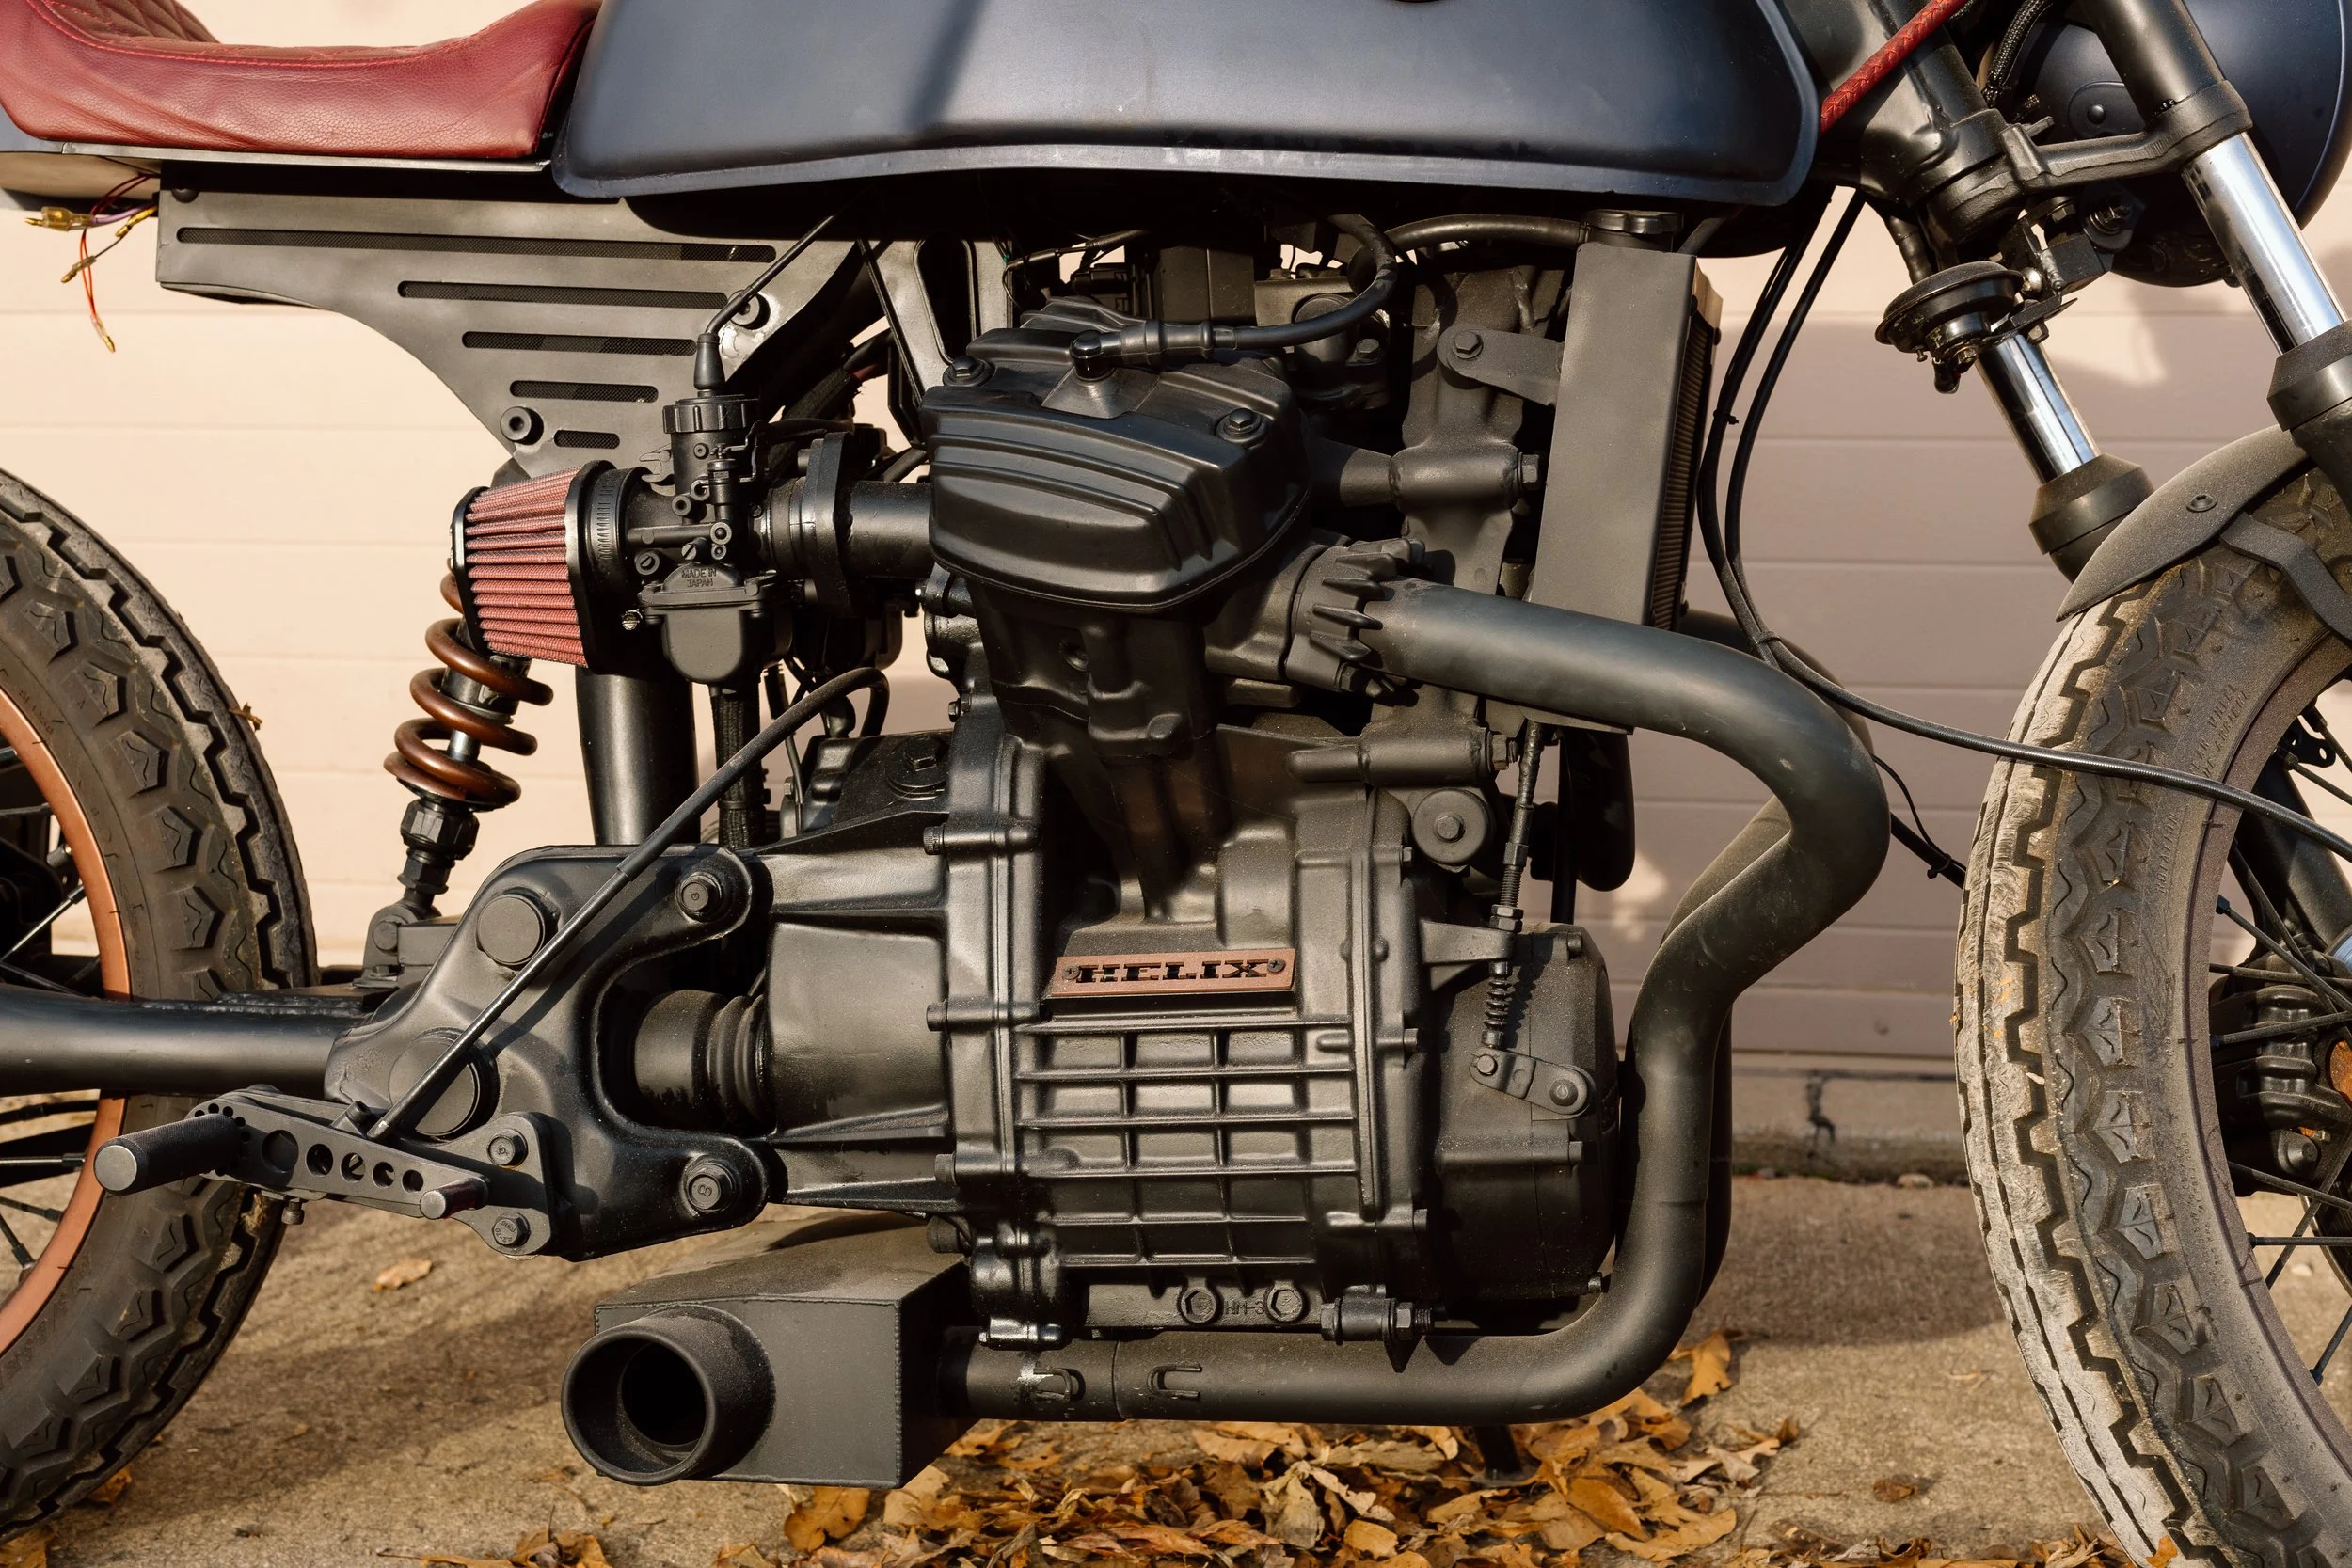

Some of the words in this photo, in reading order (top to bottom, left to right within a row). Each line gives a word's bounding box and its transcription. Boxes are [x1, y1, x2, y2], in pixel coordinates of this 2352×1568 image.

[681, 567, 707, 578] MADE
[707, 567, 717, 578] IN
[686, 578, 714, 588] JAPAN
[1075, 958, 1269, 984] HELIX
[1224, 1300, 1265, 1315] HM-3
